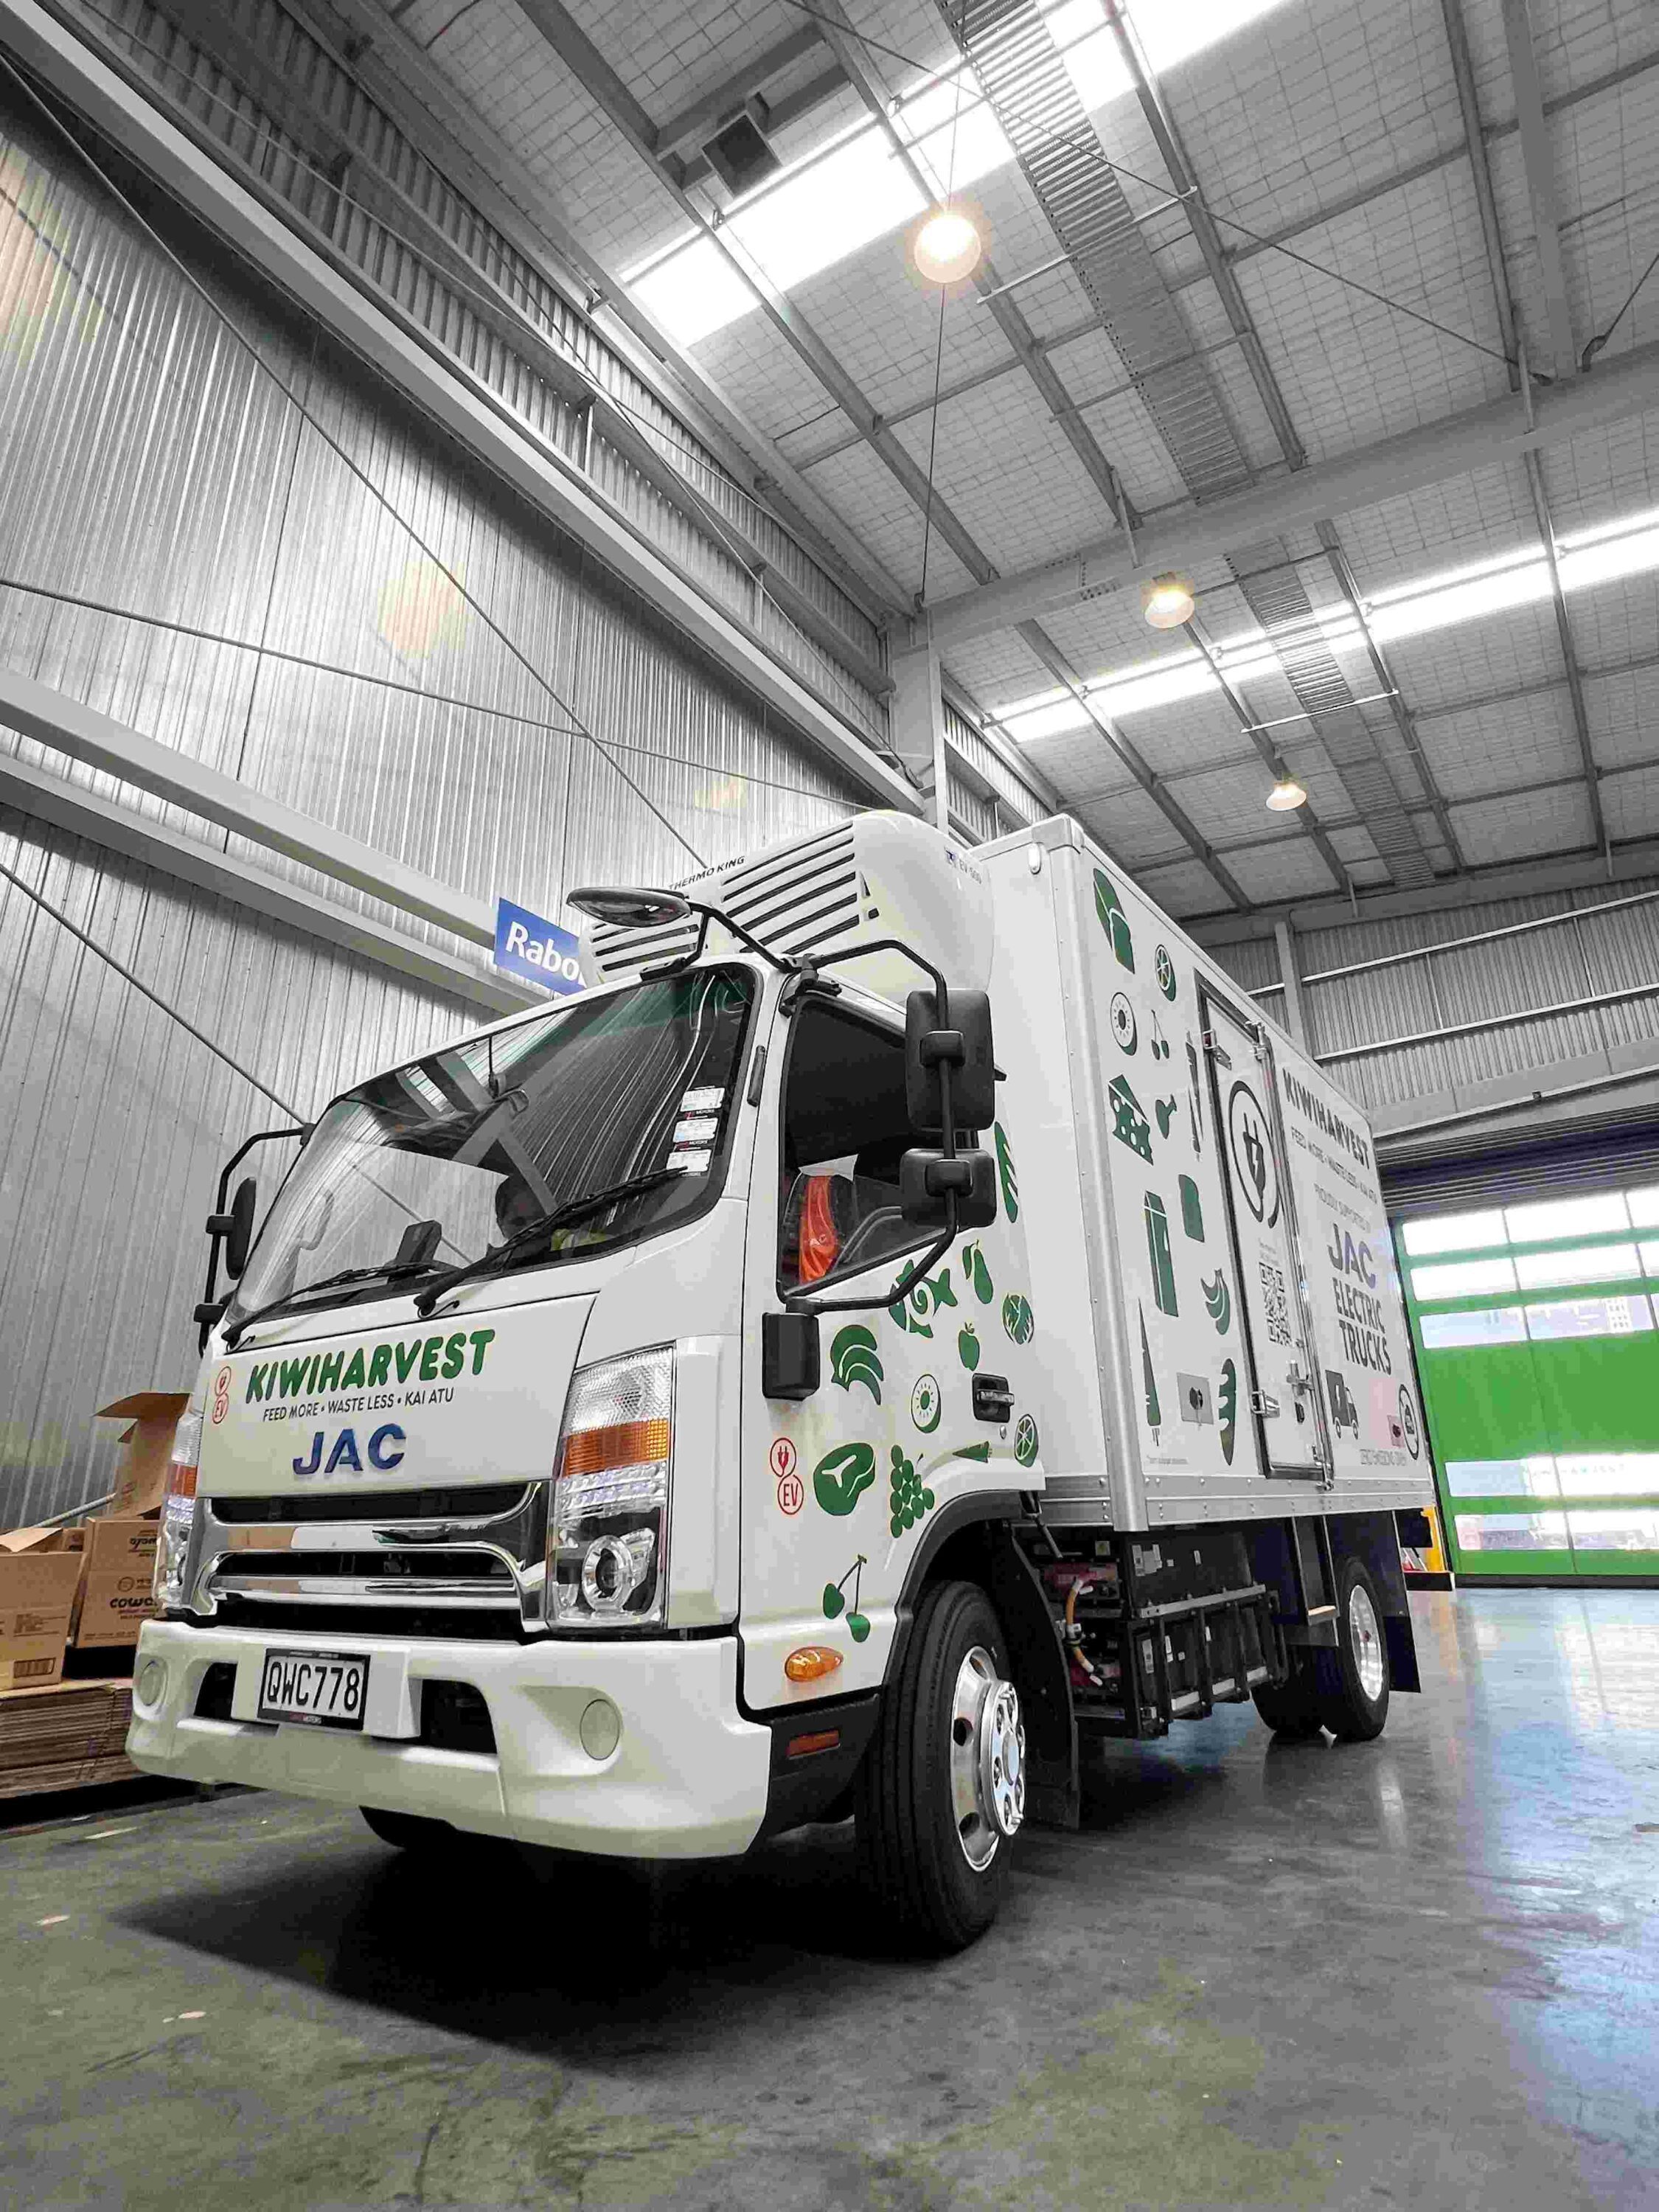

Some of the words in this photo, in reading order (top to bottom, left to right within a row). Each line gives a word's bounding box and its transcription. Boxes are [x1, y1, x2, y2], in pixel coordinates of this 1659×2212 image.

[669, 867, 714, 890] THERMO
[716, 855, 745, 873] KING
[505, 921, 587, 987] Rabo
[1282, 1068, 1370, 1170] KIWIHARVEST
[1327, 1222, 1377, 1290] JAC
[1332, 1277, 1385, 1334] ELECTRIC
[246, 1329, 495, 1404] KIWIHARVEST
[1339, 1320, 1391, 1375] TRUCKS
[262, 1408, 287, 1422] FEED
[288, 1402, 319, 1419] MORE
[327, 1397, 365, 1414] WASTE
[367, 1393, 394, 1411] LESS
[404, 1391, 427, 1407] KAI
[428, 1387, 454, 1403] ATU
[292, 1422, 406, 1475] JAC
[783, 1483, 799, 1506] EV
[267, 1661, 360, 1711] QWC778
